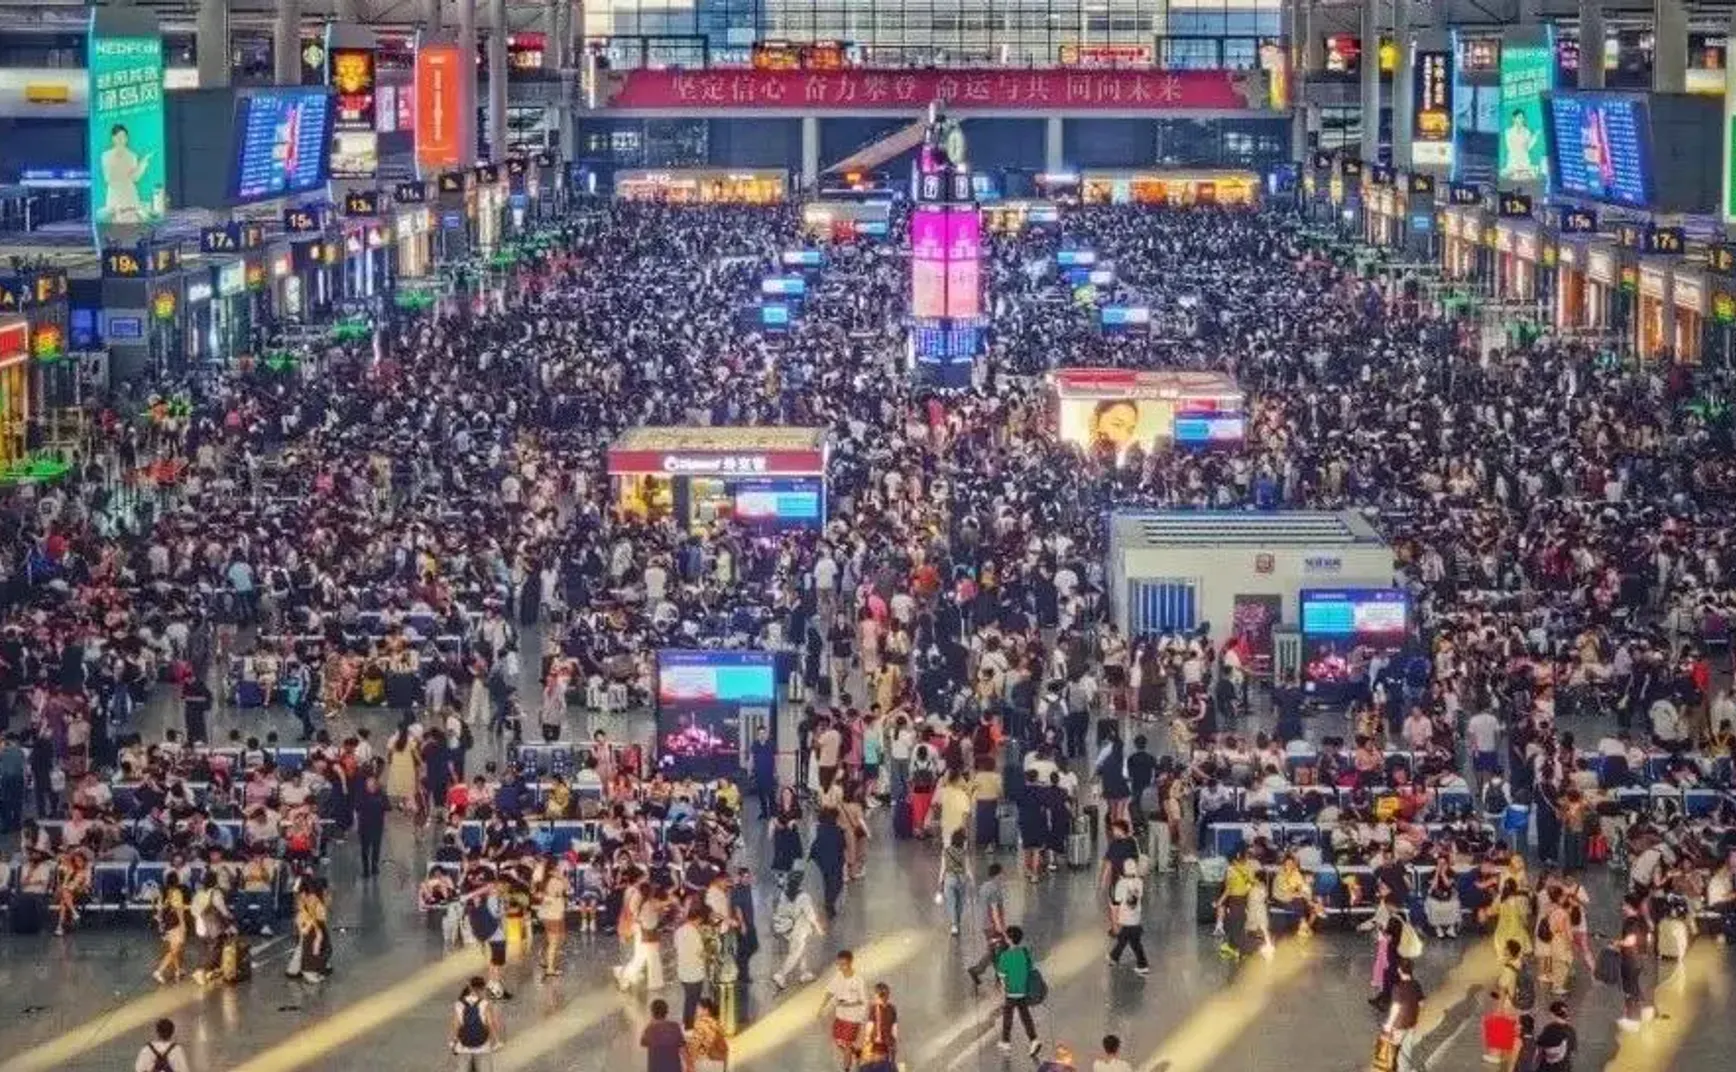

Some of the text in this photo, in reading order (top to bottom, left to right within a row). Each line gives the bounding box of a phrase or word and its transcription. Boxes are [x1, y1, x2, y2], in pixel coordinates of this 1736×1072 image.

[672, 74, 1183, 102] 坚定信心 奋力攀登 命运与共 同向未来
